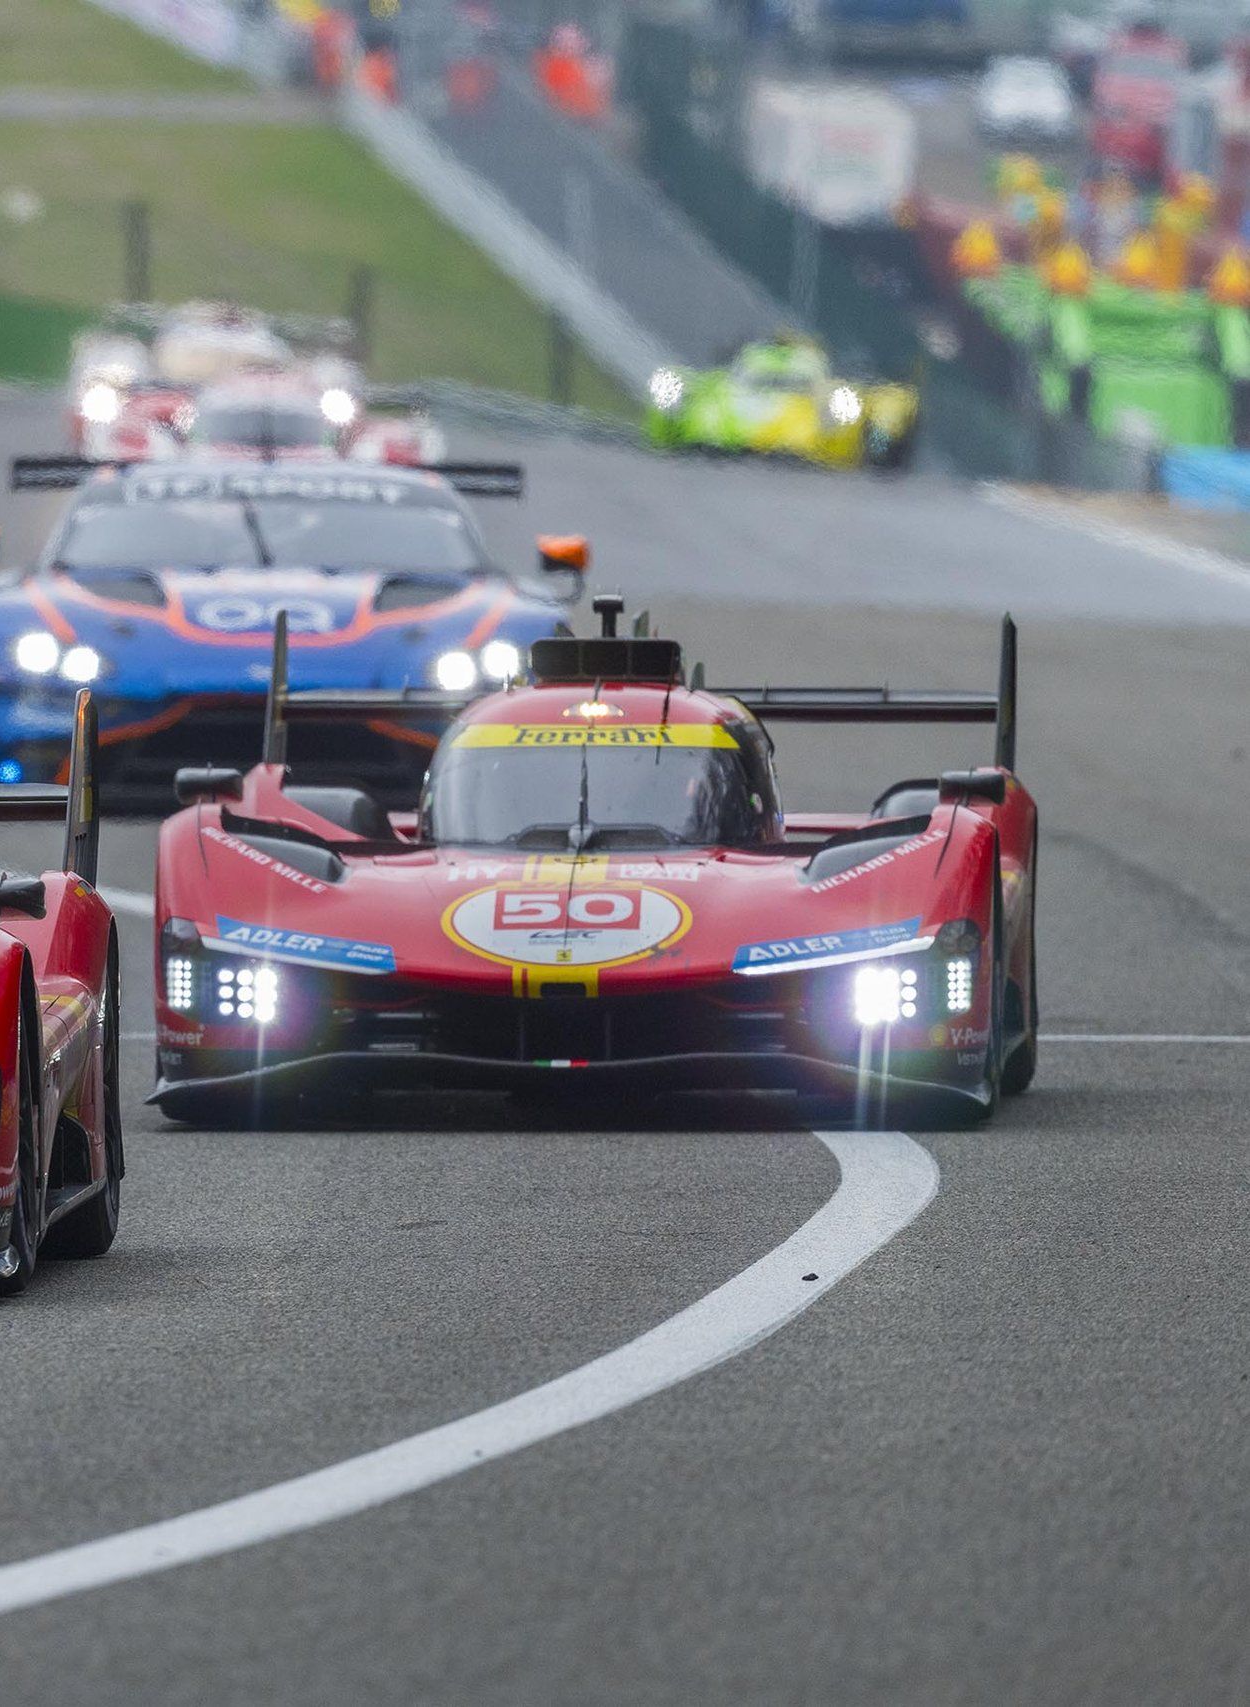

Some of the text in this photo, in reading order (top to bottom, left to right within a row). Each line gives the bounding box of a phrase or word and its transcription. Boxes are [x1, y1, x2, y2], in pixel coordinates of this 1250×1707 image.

[512, 727, 674, 744] Ferrari
[810, 829, 949, 894] RICHARD MILLE
[270, 861, 328, 894] MILLE
[502, 893, 634, 925] 50
[224, 926, 325, 952] ADLER
[748, 935, 845, 962] ADLER
